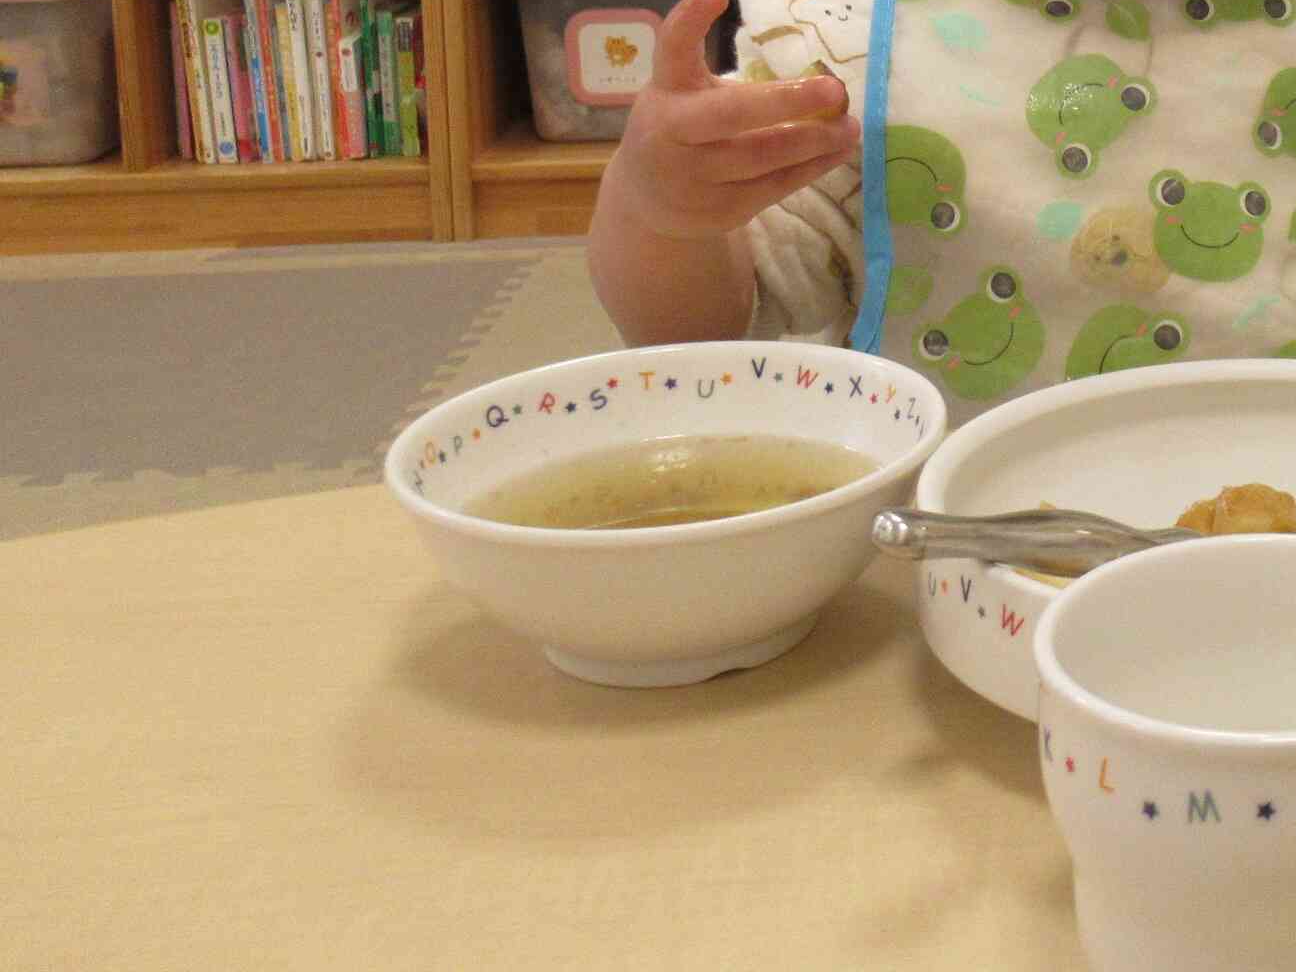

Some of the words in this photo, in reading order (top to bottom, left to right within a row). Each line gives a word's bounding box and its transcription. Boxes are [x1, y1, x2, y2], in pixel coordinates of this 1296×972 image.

[453, 435, 463, 455] P
[486, 405, 509, 428] Q
[538, 392, 556, 414] R
[590, 389, 608, 410] S
[639, 371, 656, 390] T
[697, 379, 715, 399] U
[751, 357, 767, 379] V
[796, 365, 819, 389] W
[849, 375, 863, 399] X
[960, 575, 972, 603] V
[1001, 603, 1025, 637] W
[1099, 756, 1115, 794] L
[1186, 789, 1222, 824] M
